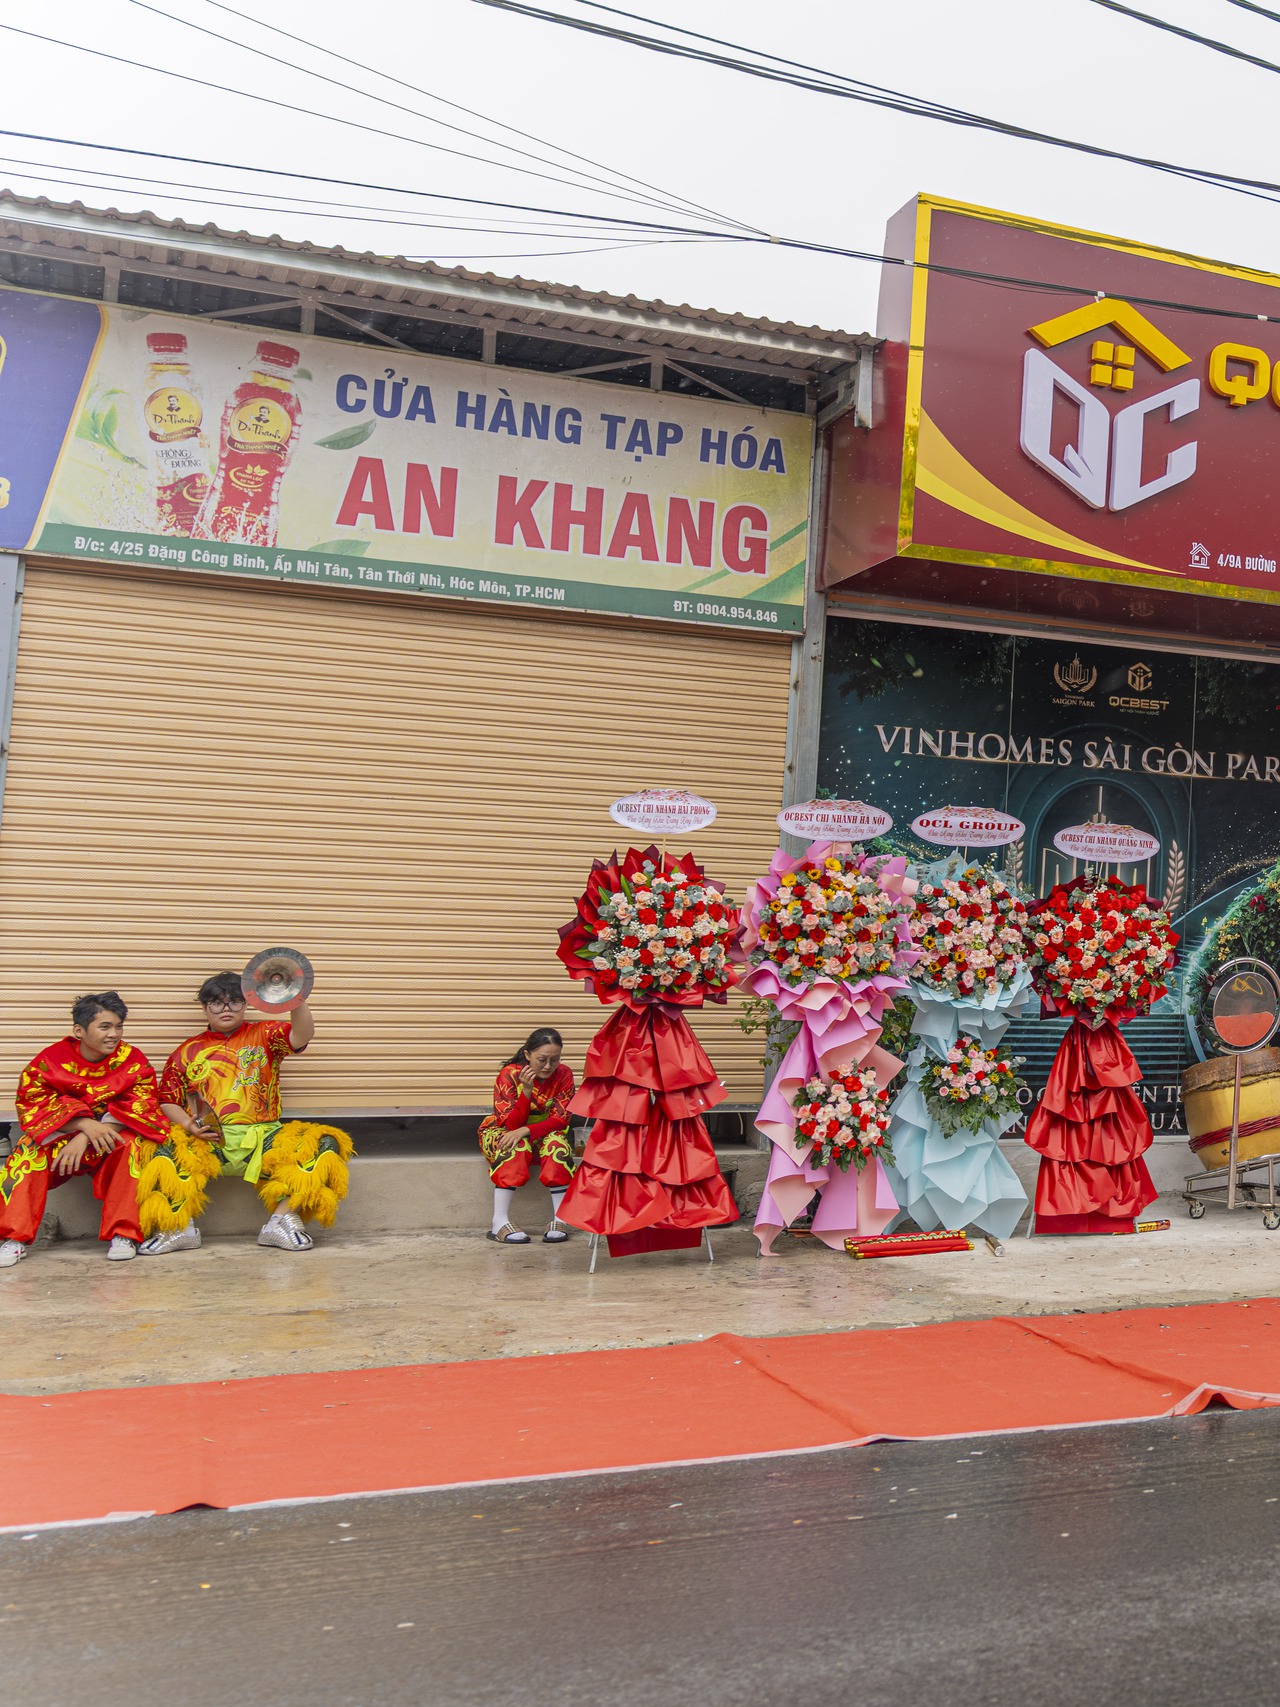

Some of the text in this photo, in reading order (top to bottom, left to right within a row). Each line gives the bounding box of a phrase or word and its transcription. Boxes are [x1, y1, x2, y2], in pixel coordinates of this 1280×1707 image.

[335, 367, 787, 474] CỬA HÀNG TẠP HÓA
[335, 456, 769, 575] AN KHANG
[74, 536, 104, 552] Đ/c:
[109, 541, 143, 556] 4/25
[148, 545, 186, 562] Đặng
[191, 549, 228, 567] Công
[273, 554, 292, 574] Ấp
[296, 560, 320, 577] Nhị
[324, 563, 353, 580] Tân,
[358, 566, 382, 582] Tân
[387, 570, 415, 584] Thới
[420, 573, 445, 589] Nhì,
[450, 576, 474, 591] Hóc
[479, 580, 511, 598] Môn,
[514, 584, 565, 601] TP.HCM
[1217, 553, 1241, 569] 4/9A
[1245, 554, 1276, 573] ĐƯỜNG
[673, 600, 778, 623] ĐT: 0904.954.846
[1052, 698, 1095, 708] SAIGON PARK
[1109, 696, 1170, 710] QCBEST
[873, 723, 1073, 766] VINHOMES
[1082, 736, 1132, 772] SÀI
[1141, 741, 1219, 778] GÒN
[616, 802, 641, 813] QCBEST
[642, 803, 654, 813] CHI
[784, 812, 814, 822] QCBEST
[816, 813, 829, 823] CHI
[919, 819, 1020, 831] QCL GROUP
[1085, 834, 1096, 844] CHI
